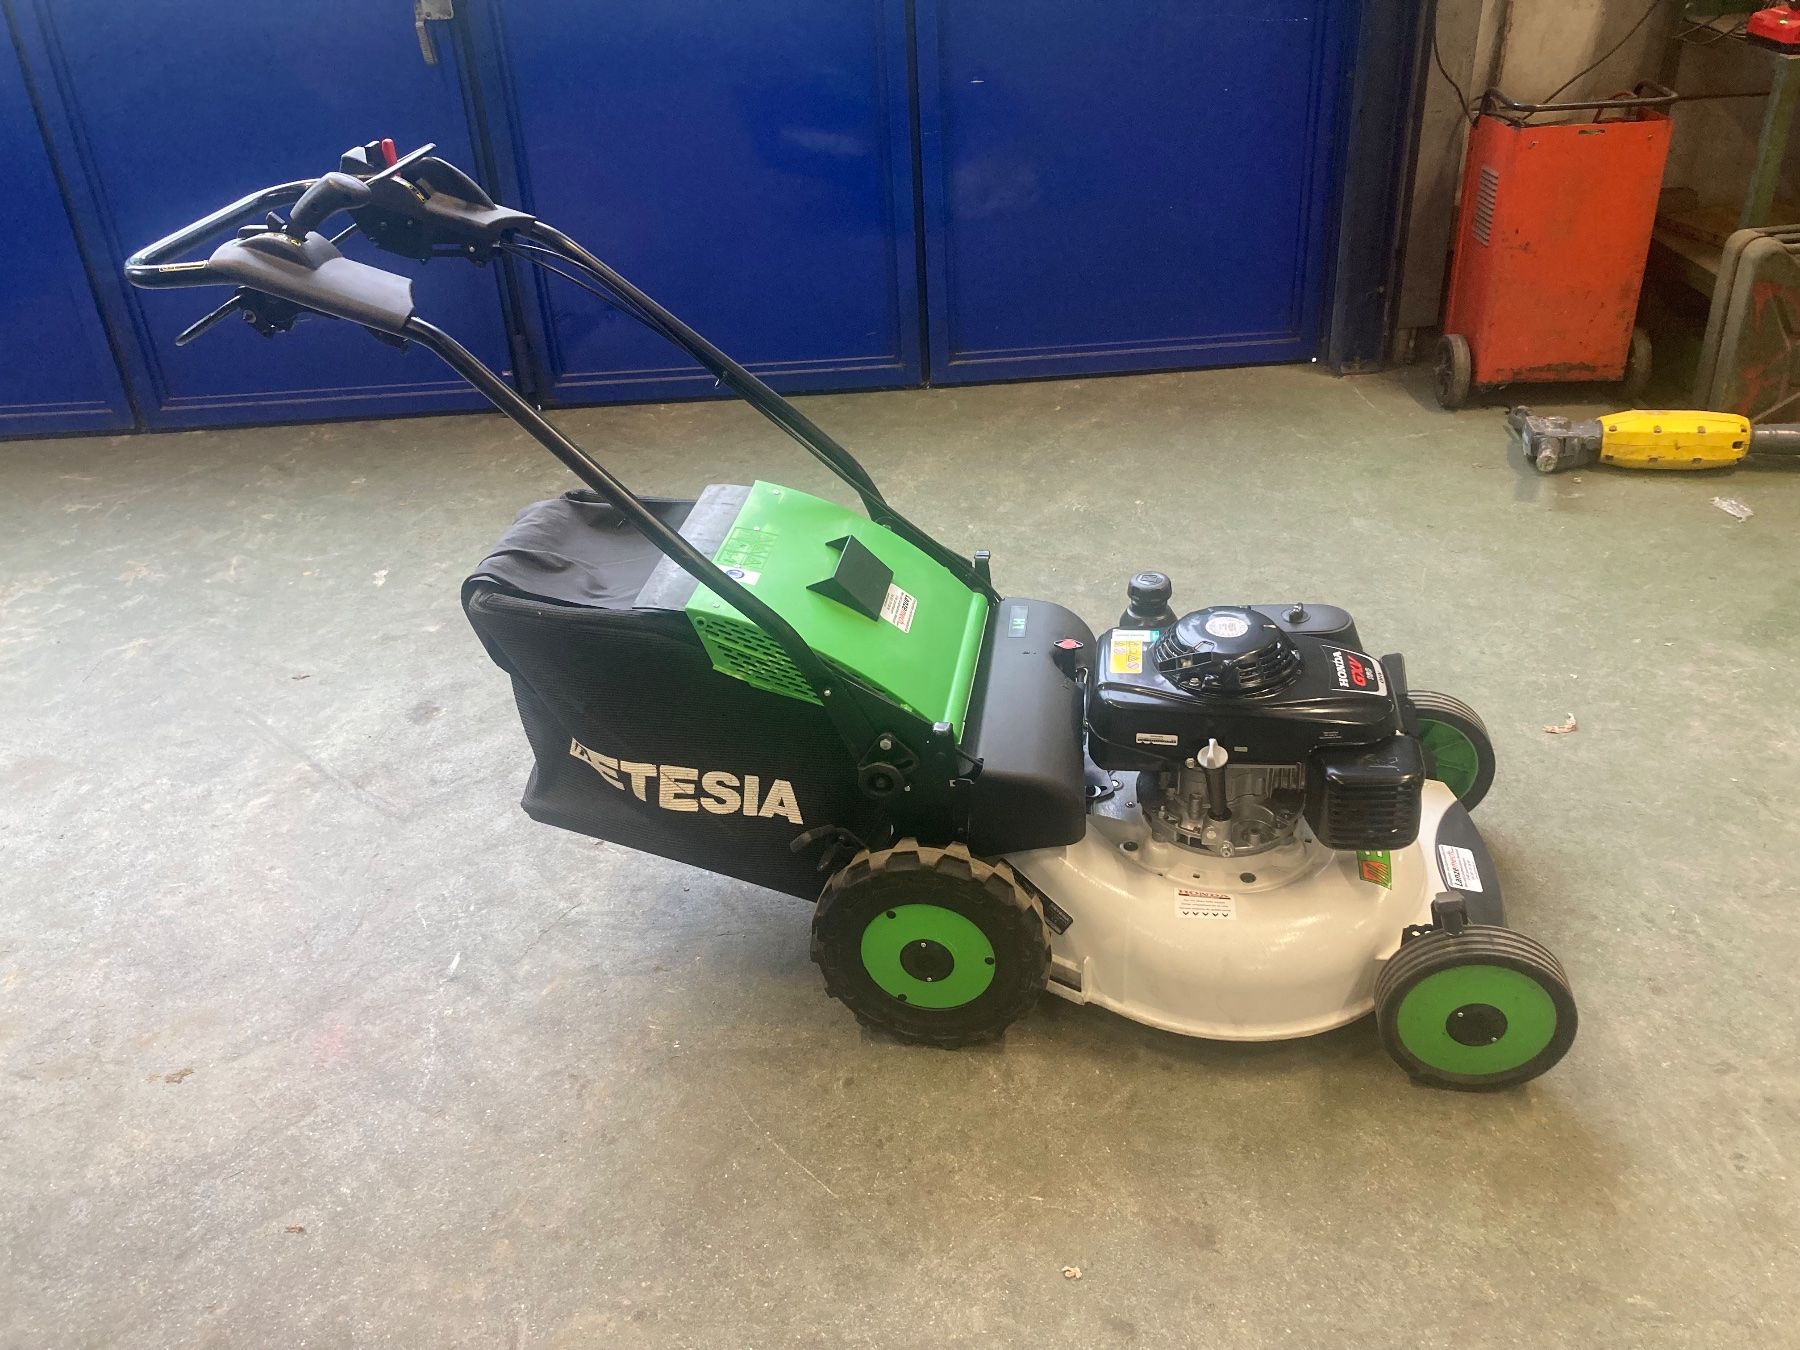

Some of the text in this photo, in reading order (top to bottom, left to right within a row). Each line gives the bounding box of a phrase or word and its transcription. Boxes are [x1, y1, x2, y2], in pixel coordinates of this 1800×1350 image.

[1332, 651, 1349, 688] HONDA
[1347, 655, 1367, 686] GXV
[1179, 889, 1230, 898] HONDA
